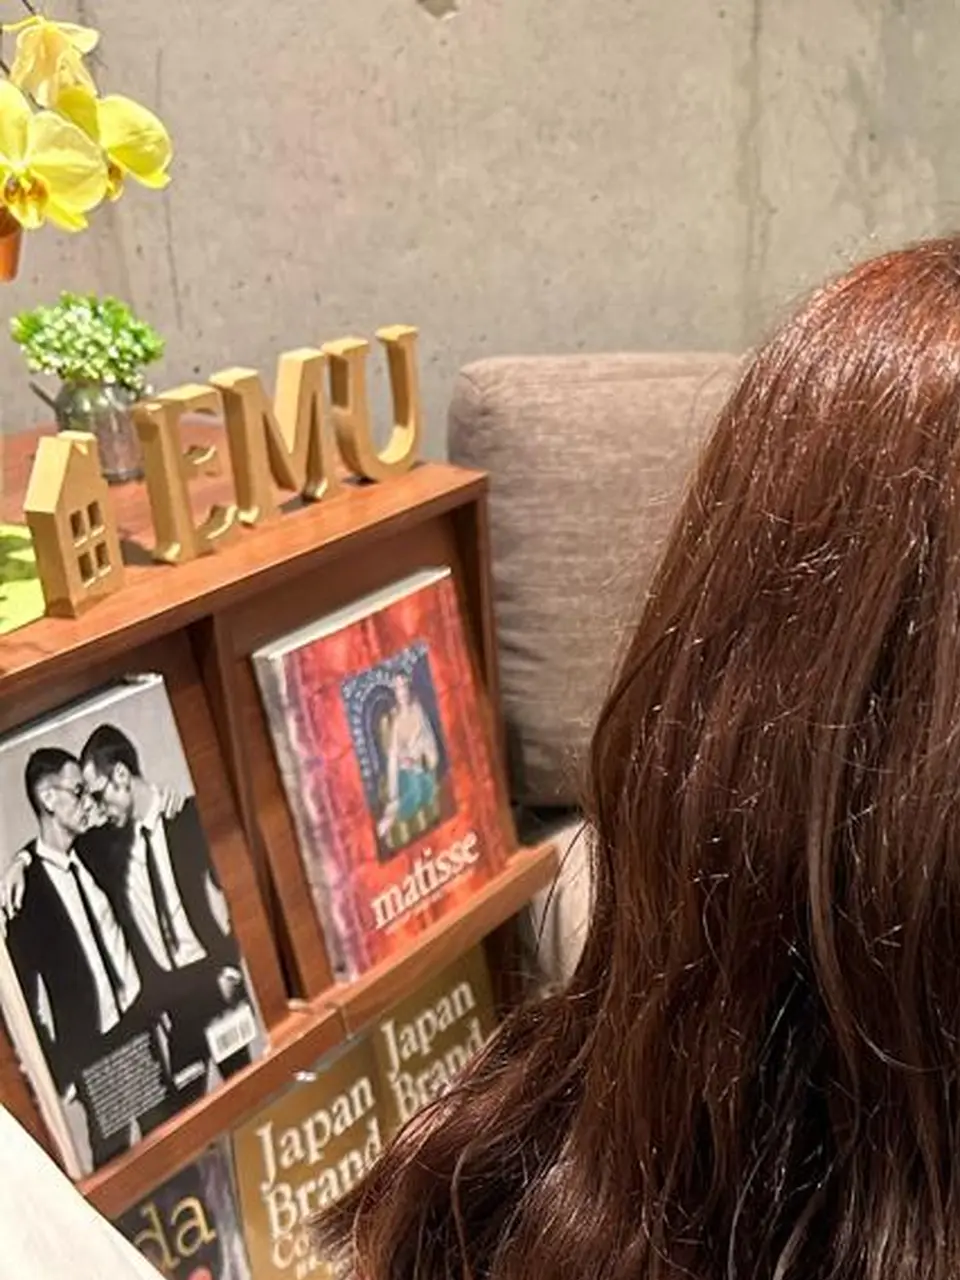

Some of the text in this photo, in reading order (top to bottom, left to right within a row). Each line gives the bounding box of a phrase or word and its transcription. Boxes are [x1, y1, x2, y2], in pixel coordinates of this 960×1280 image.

[133, 324, 419, 564] EMU
[370, 831, 480, 930] matisse
[381, 982, 476, 1082] Japan
[392, 1016, 486, 1122] Brand
[258, 1074, 376, 1194] Japan
[267, 1117, 383, 1240] Brand
[134, 1196, 216, 1270] da
